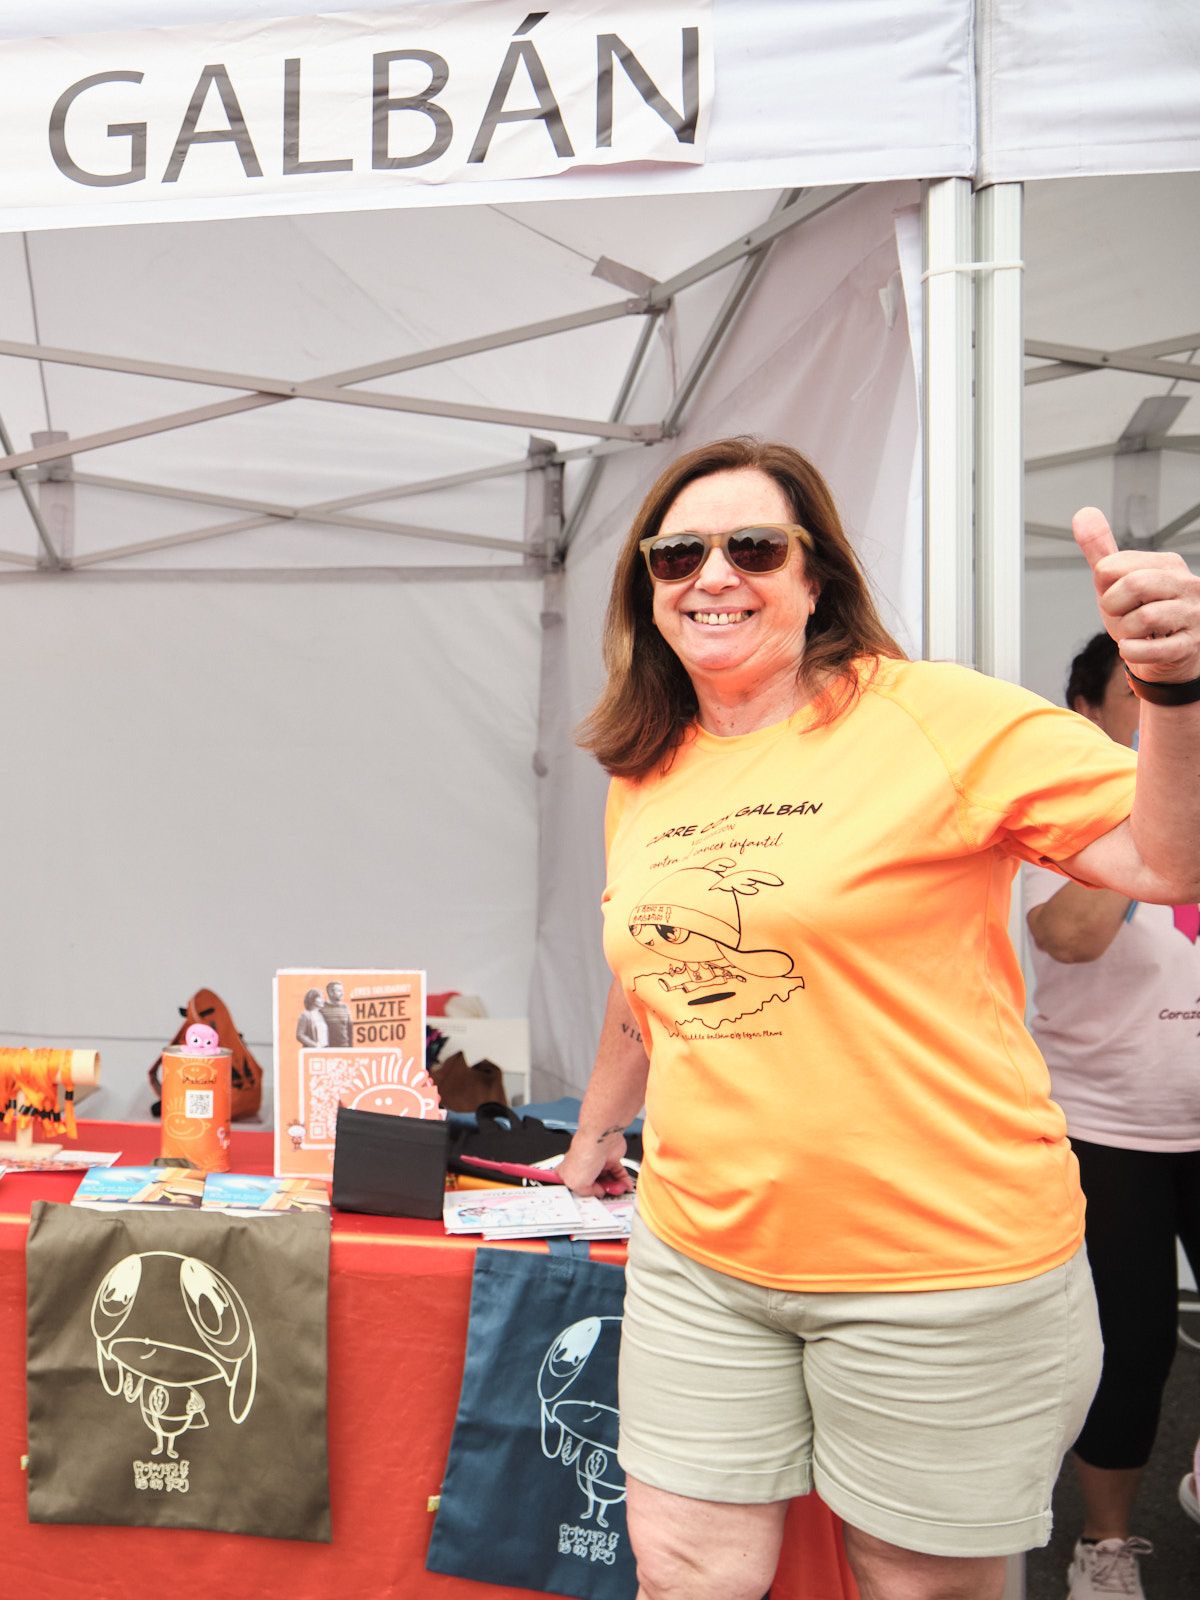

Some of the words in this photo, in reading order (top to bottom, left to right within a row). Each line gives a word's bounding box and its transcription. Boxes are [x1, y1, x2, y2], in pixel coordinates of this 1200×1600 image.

[48, 12, 700, 189] GALBÁN
[735, 801, 823, 817] GALBÁN
[729, 832, 783, 854] infantil
[356, 1000, 407, 1020] HAZTE
[356, 1023, 406, 1043] SOCIO
